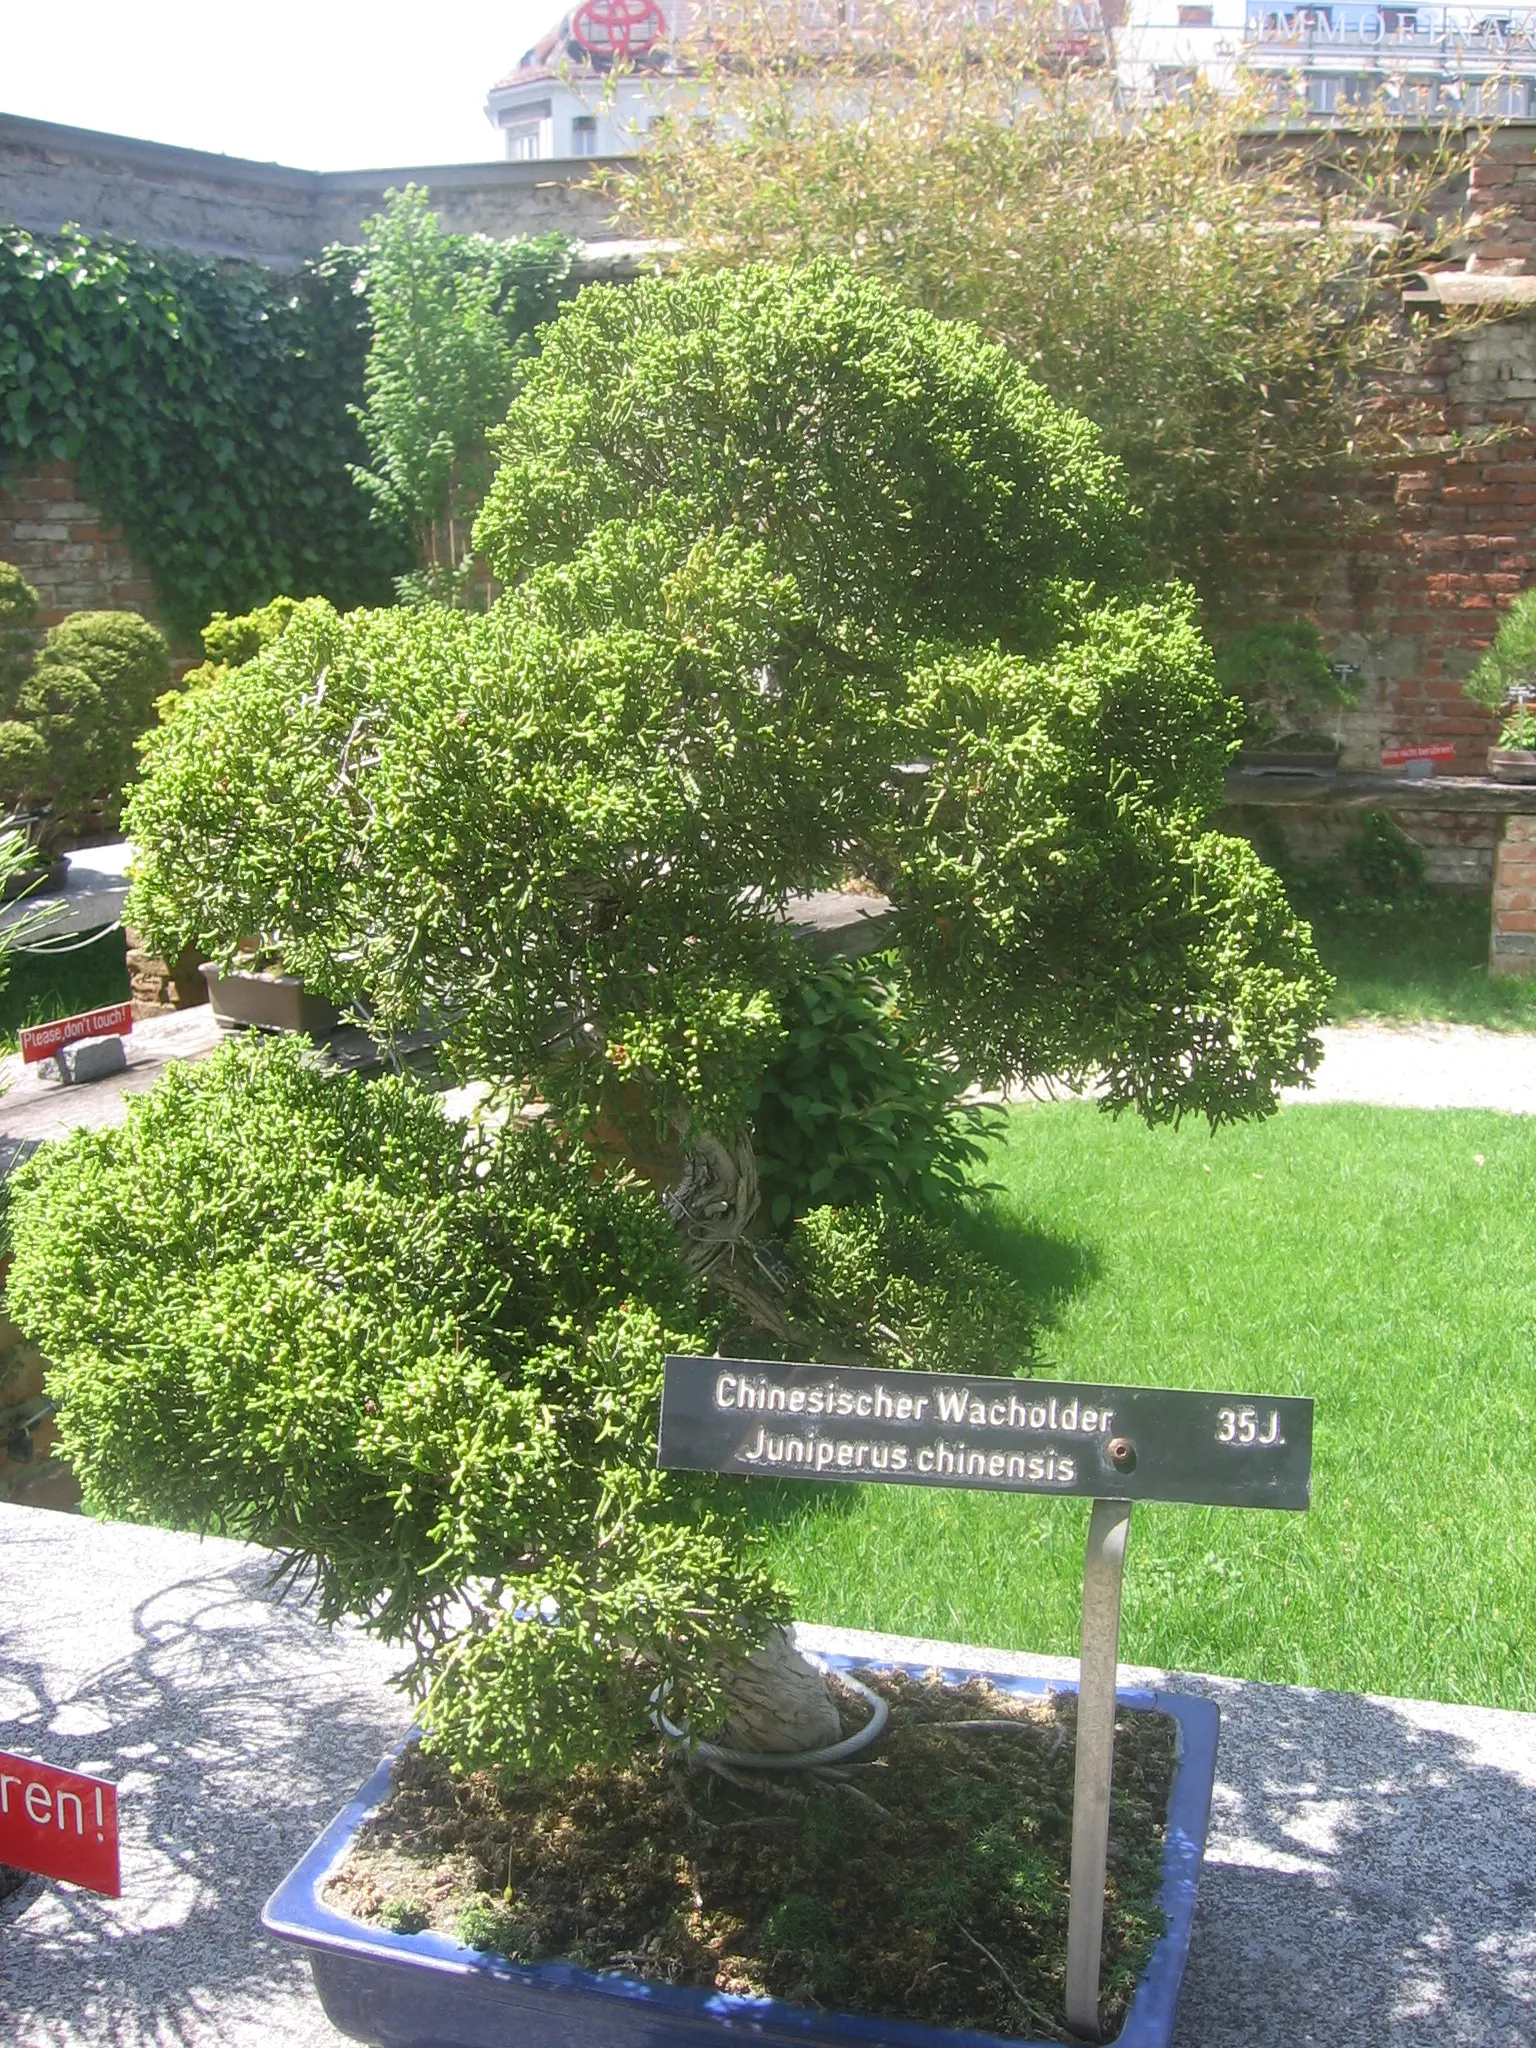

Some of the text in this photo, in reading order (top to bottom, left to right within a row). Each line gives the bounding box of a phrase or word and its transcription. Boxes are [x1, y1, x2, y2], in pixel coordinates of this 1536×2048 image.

[93, 1006, 127, 1030] touch!
[716, 1372, 1115, 1433] Chinesischer Wacholder
[744, 1426, 1076, 1482] Juniperus chinensis
[0, 1773, 105, 1843] ren!
